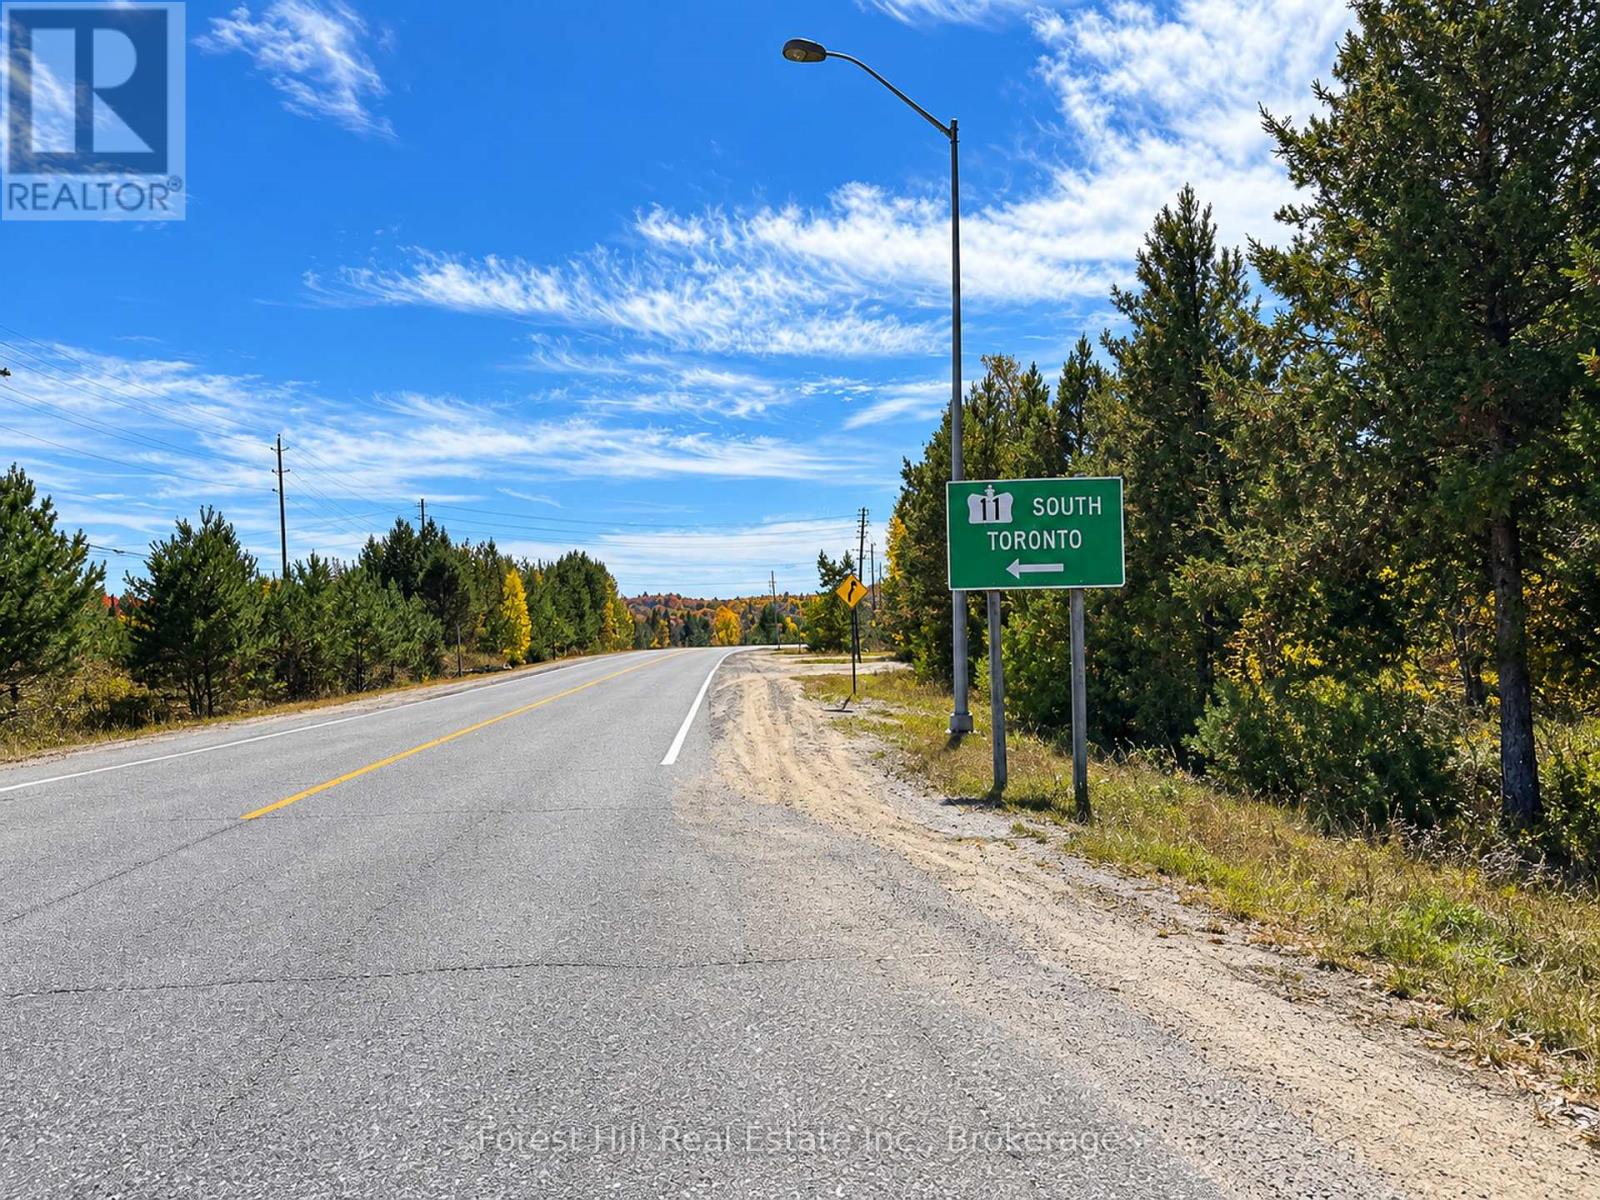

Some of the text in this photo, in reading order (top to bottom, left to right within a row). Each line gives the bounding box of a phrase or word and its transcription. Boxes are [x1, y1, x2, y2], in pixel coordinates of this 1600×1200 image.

[980, 496, 1102, 521] 11 SOUTH
[987, 529, 1082, 551] TORONTO
